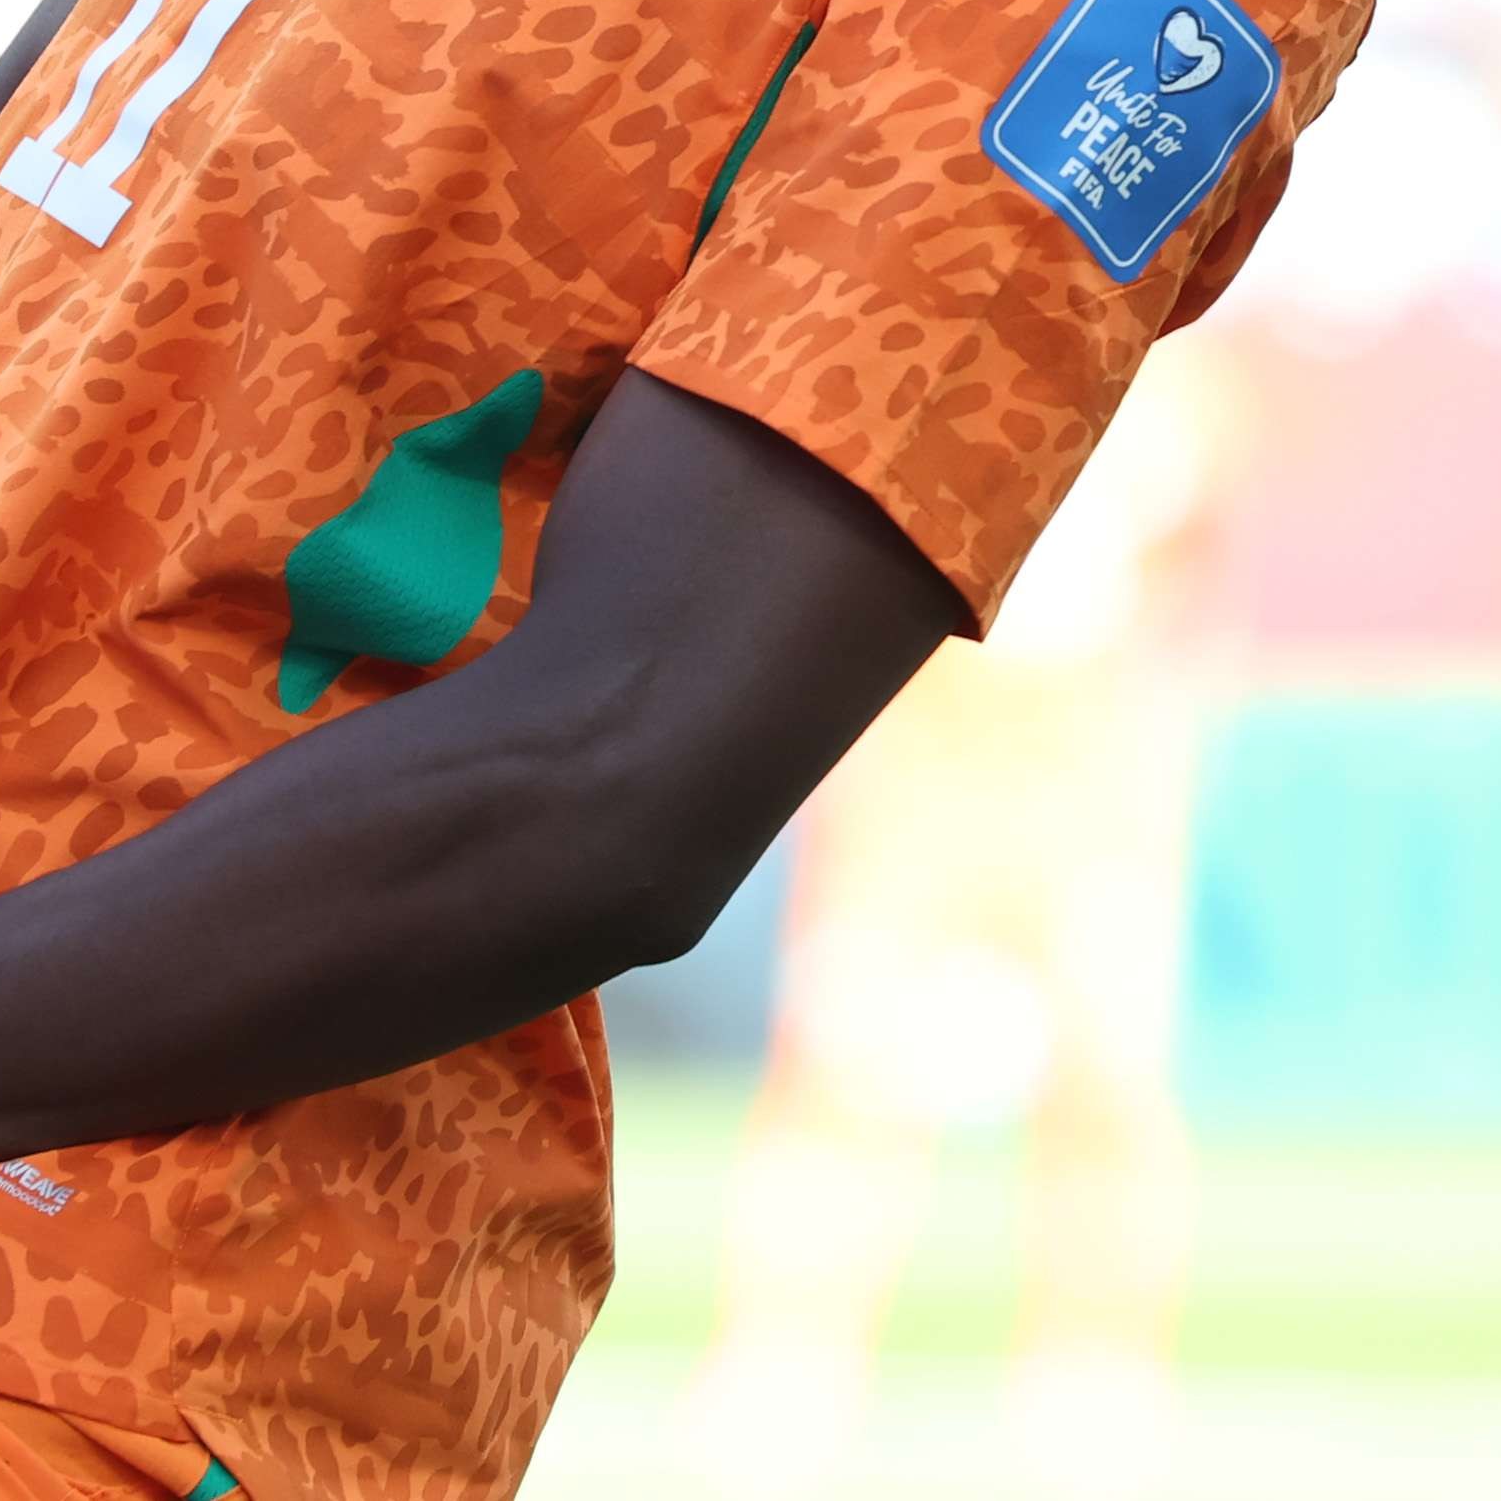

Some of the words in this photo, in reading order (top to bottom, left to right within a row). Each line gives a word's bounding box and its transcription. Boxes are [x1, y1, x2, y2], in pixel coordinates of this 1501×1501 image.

[1086, 58, 1159, 129] Unite
[1142, 111, 1188, 157] For
[1058, 156, 1104, 210] FIFA
[1059, 99, 1156, 200] PEACE
[0, 1158, 75, 1205] WEAVE
